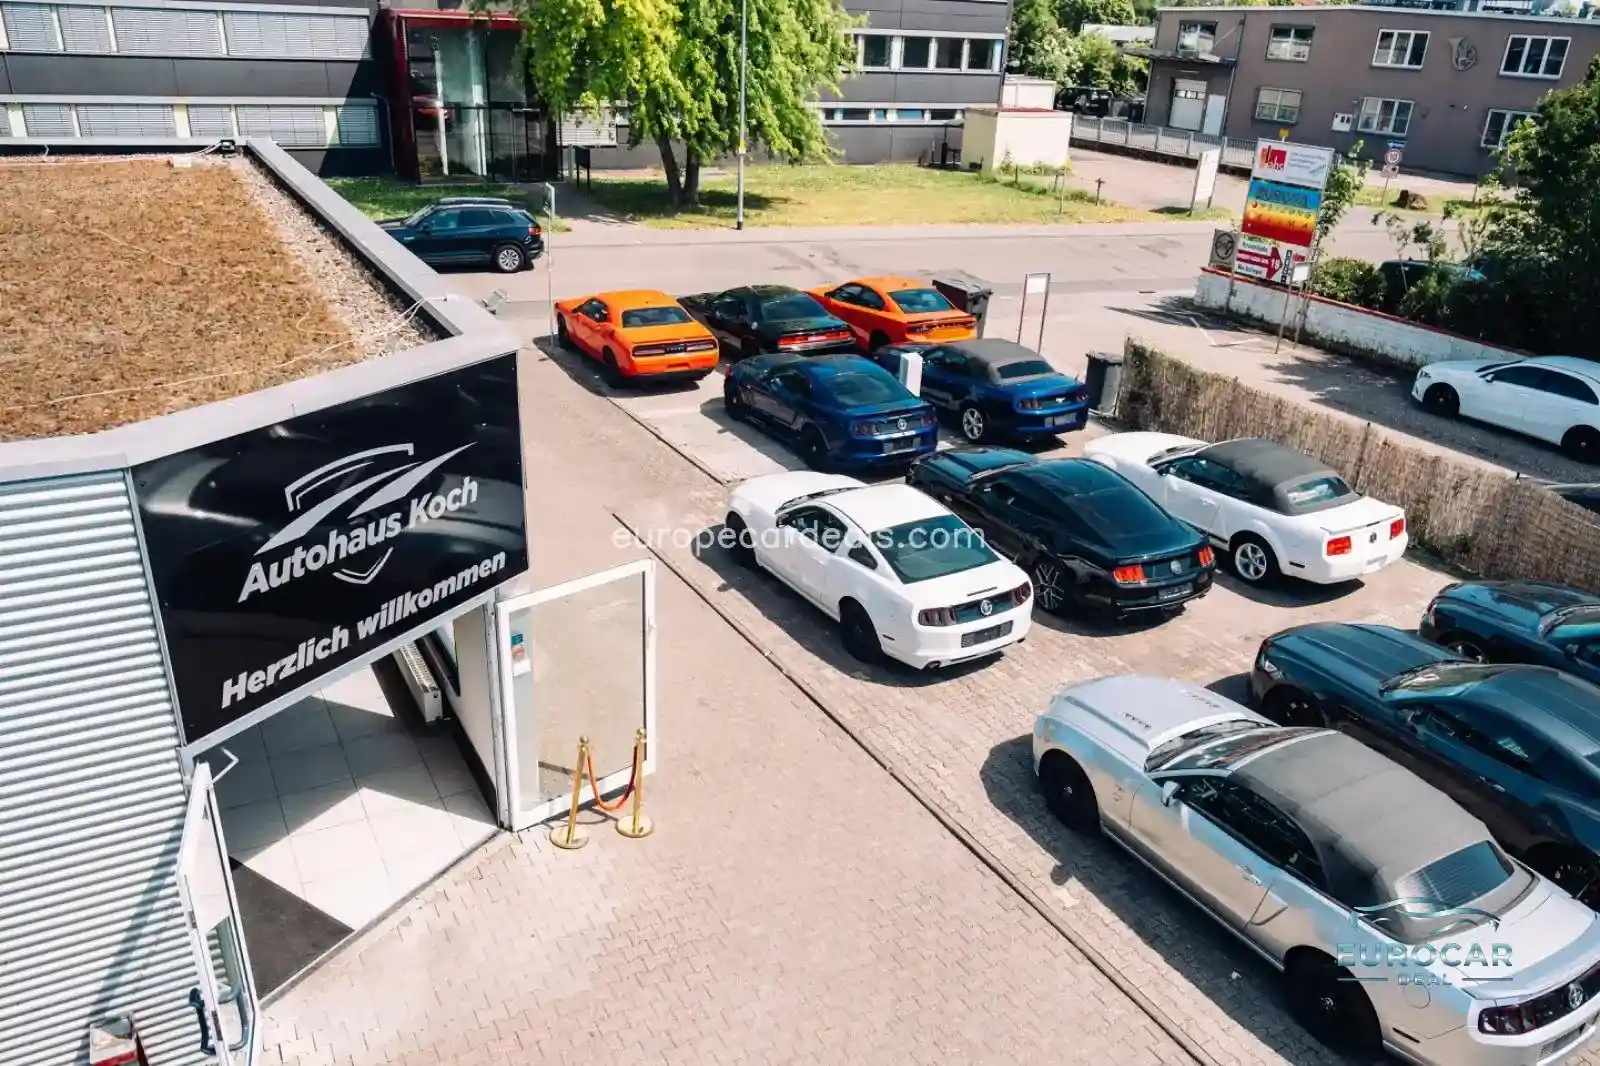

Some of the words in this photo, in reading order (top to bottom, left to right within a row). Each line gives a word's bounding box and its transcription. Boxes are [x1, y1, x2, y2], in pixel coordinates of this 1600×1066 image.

[237, 512, 401, 604] Autohaus
[408, 475, 479, 529] Koch
[221, 624, 350, 710] Herzlich
[356, 550, 507, 641] willkommen
